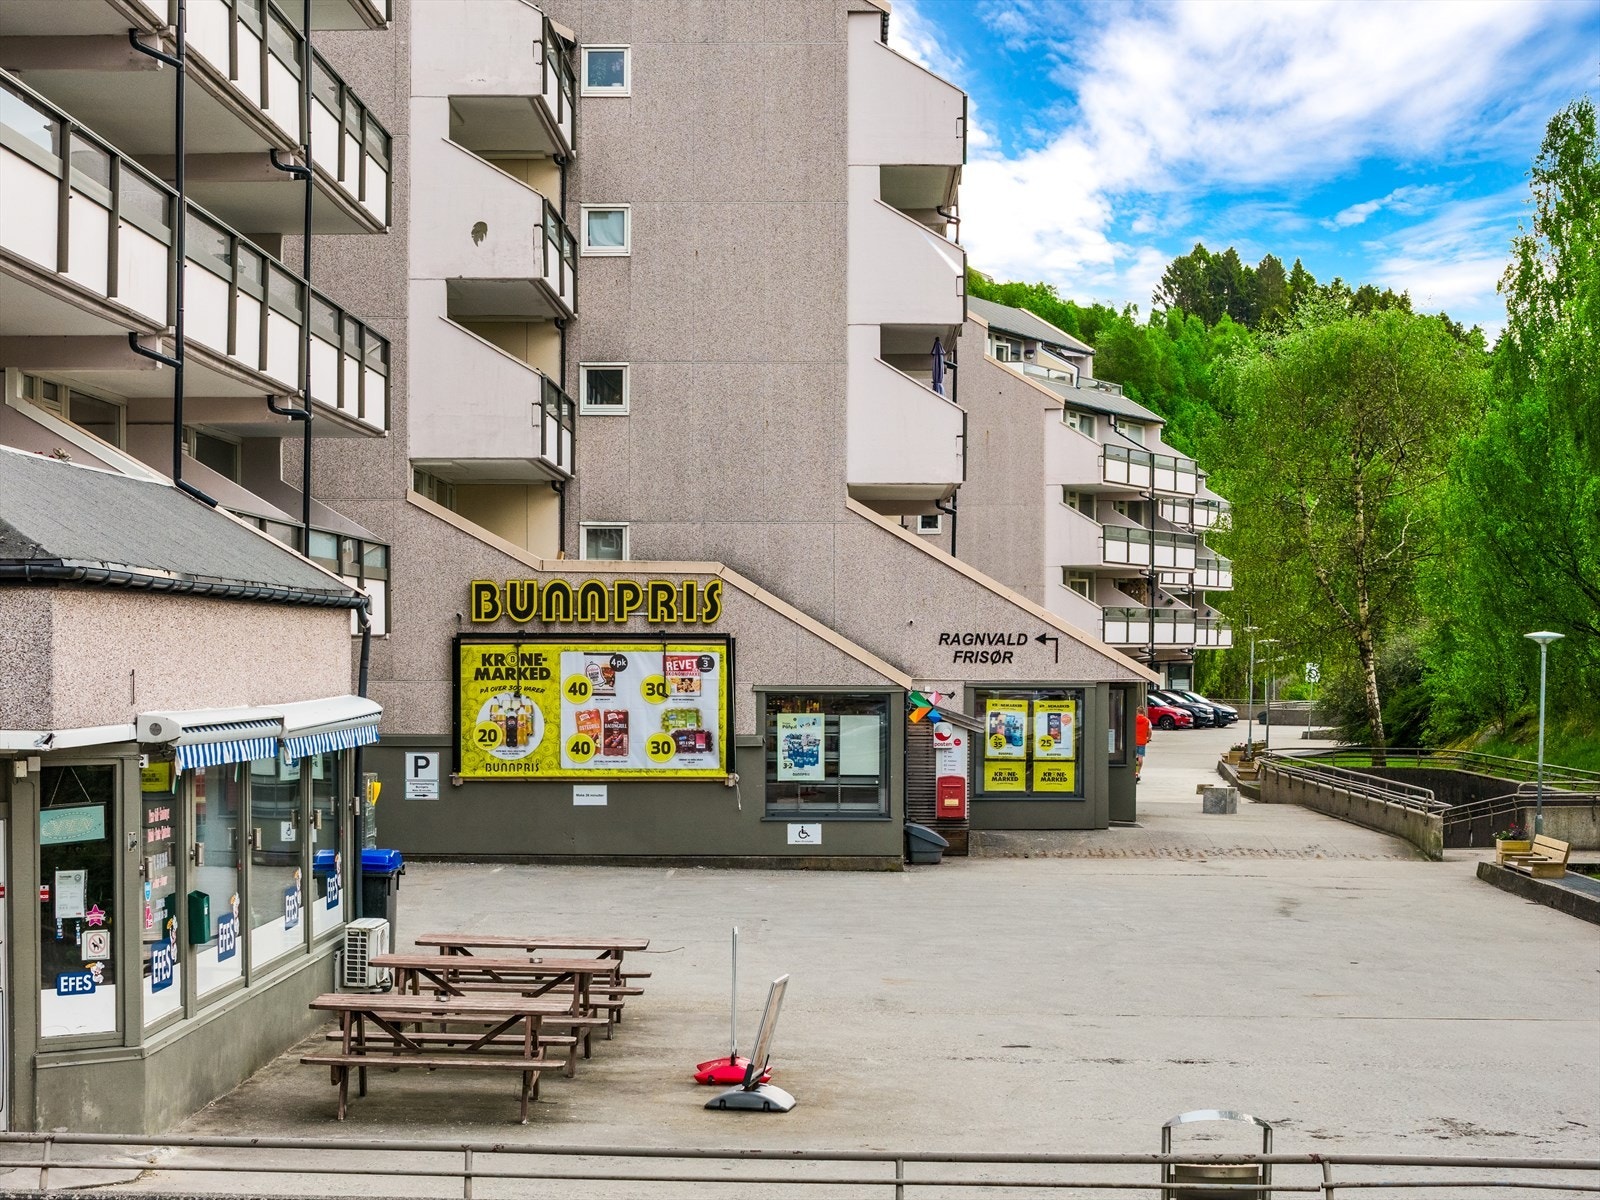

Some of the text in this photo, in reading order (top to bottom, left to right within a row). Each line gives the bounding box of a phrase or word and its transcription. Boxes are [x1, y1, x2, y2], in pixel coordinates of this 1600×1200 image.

[471, 579, 723, 624] BUNNPRIS
[938, 633, 1028, 646] RAGNVALD
[953, 650, 1014, 665] FRISØR
[474, 667, 551, 681] MARKED
[568, 682, 588, 696] 40
[645, 682, 666, 696] 30
[478, 729, 498, 742] 20
[571, 741, 590, 755] 40
[651, 741, 671, 755] 30
[414, 756, 430, 777] P
[485, 762, 539, 772] BUNNPRIS
[219, 919, 234, 954] EFES
[153, 945, 171, 984] EFES
[60, 974, 92, 992] EFES
